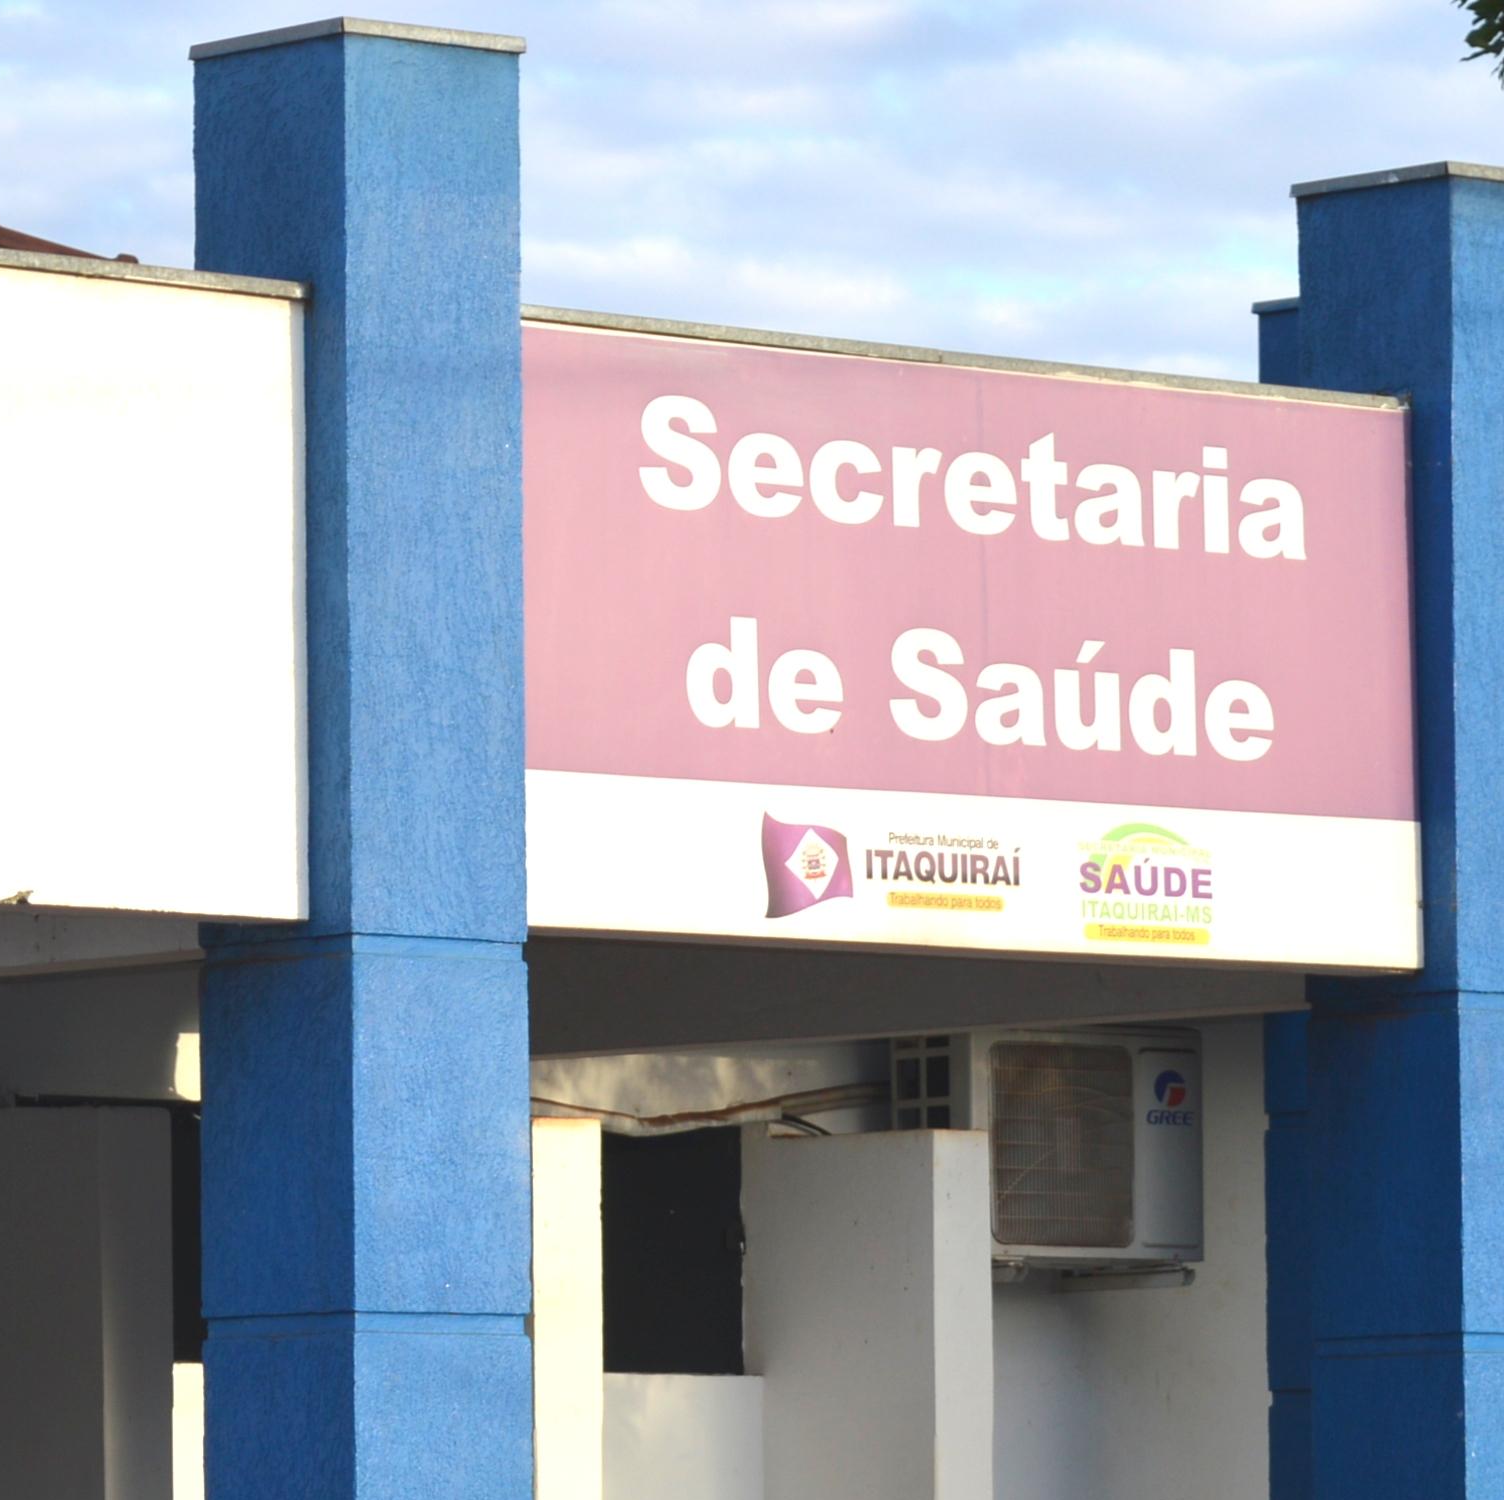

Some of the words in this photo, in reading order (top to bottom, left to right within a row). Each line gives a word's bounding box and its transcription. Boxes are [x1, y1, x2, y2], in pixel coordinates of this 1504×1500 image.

[638, 394, 1308, 562] Secretaria
[685, 615, 845, 736] de
[888, 627, 1276, 763] Saúde
[888, 831, 934, 846] Prefeitura
[937, 834, 984, 850] Municipal
[986, 837, 999, 850] de
[865, 846, 1021, 887] ITAQUIRAÍ
[1079, 857, 1213, 900] SAÚDE
[888, 891, 949, 907] Trabalhando
[951, 896, 973, 909] para
[975, 896, 1002, 910] todos
[1098, 924, 1149, 939] Trabalhando
[1151, 929, 1171, 940] para
[1173, 928, 1196, 941] todos
[1146, 1109, 1195, 1126] GREE
